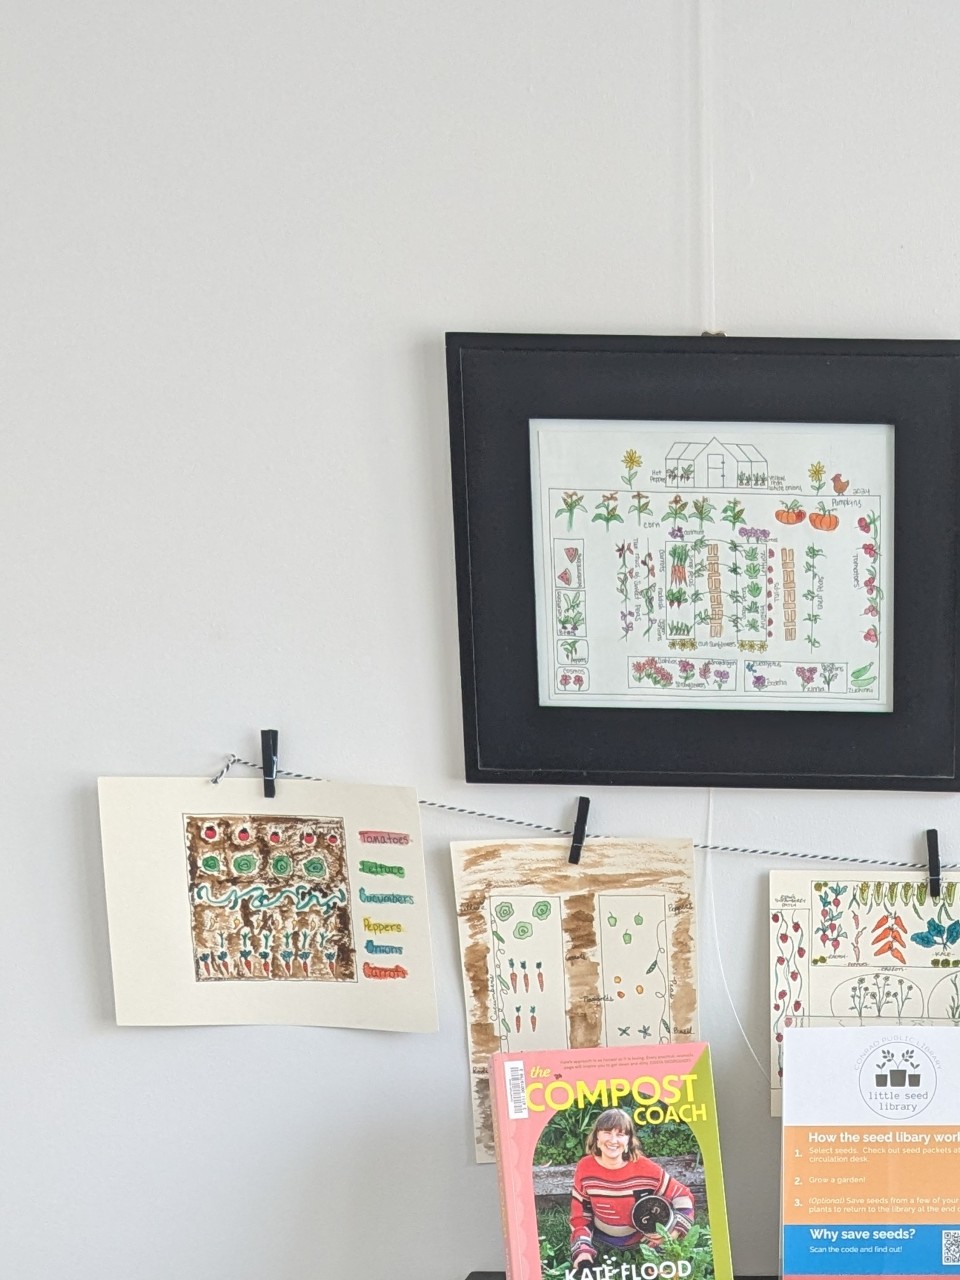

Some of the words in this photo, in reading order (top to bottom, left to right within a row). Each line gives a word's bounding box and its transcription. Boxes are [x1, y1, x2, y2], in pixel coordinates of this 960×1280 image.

[360, 831, 410, 845] Tomatoes
[362, 862, 405, 876] Lettuce
[359, 887, 415, 904] Cucumbers
[363, 917, 402, 935] Peppers
[364, 940, 403, 955] Onions
[363, 962, 408, 979] Carrots
[854, 1041, 880, 1071] CONRAD
[881, 1035, 914, 1043] PUBLIC
[916, 1041, 943, 1070] LIBRARY
[529, 1066, 551, 1078] the
[526, 1074, 698, 1112] COMPOST
[868, 1091, 900, 1100] little
[904, 1091, 929, 1100] seed
[879, 1102, 918, 1112] library
[633, 1103, 707, 1126] COACH
[808, 1132, 837, 1143] How
[839, 1132, 860, 1142] the
[863, 1132, 893, 1143] seed
[895, 1132, 931, 1145] libary
[794, 1149, 803, 1157] 1.
[922, 1147, 951, 1155] packets
[809, 1155, 848, 1163] circulation
[794, 1177, 803, 1186] 2.
[836, 1176, 866, 1185] garden!
[809, 1229, 838, 1242] Why
[841, 1230, 870, 1240] save
[872, 1229, 916, 1240] seeds?
